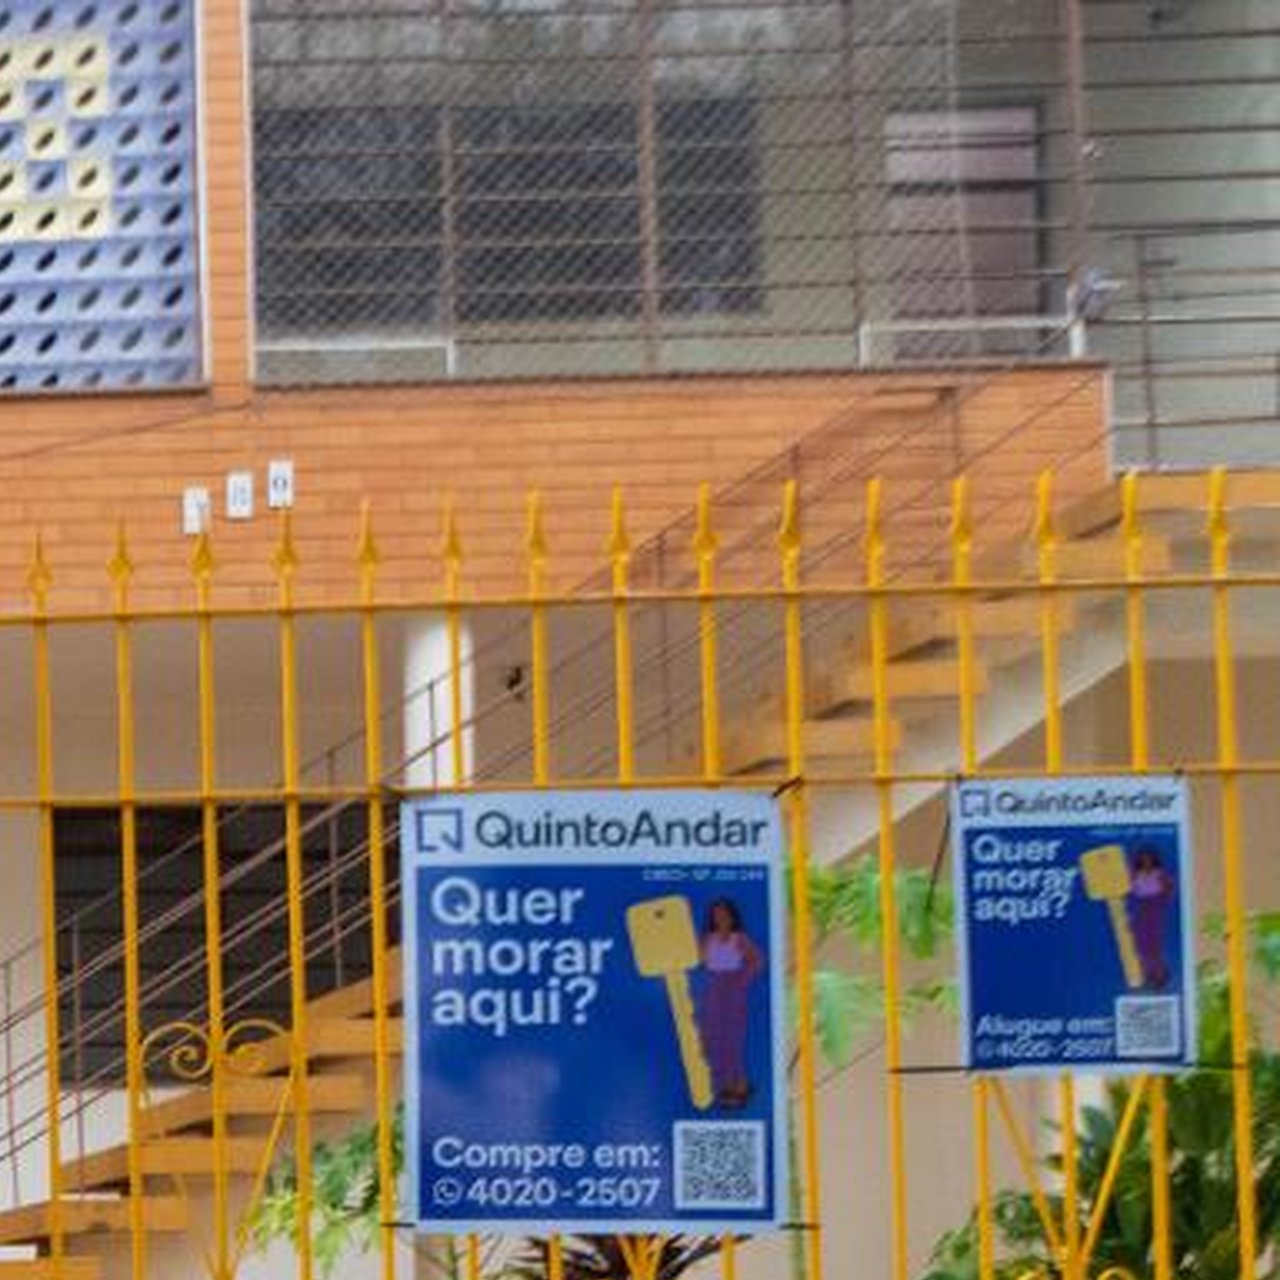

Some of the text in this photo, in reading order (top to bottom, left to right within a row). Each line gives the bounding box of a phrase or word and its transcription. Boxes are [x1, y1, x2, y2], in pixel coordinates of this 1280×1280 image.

[996, 789, 1177, 813] QuintoAndar
[474, 810, 768, 849] QuintoAndar
[972, 833, 1064, 863] Quer
[972, 866, 1079, 891] morar
[431, 875, 584, 925] Quer
[973, 892, 1071, 927] aqui?
[431, 937, 614, 975] morar
[431, 977, 599, 1037] aqui?
[432, 1136, 661, 1173] Compre em:
[466, 1177, 661, 1207] 4020-2507
